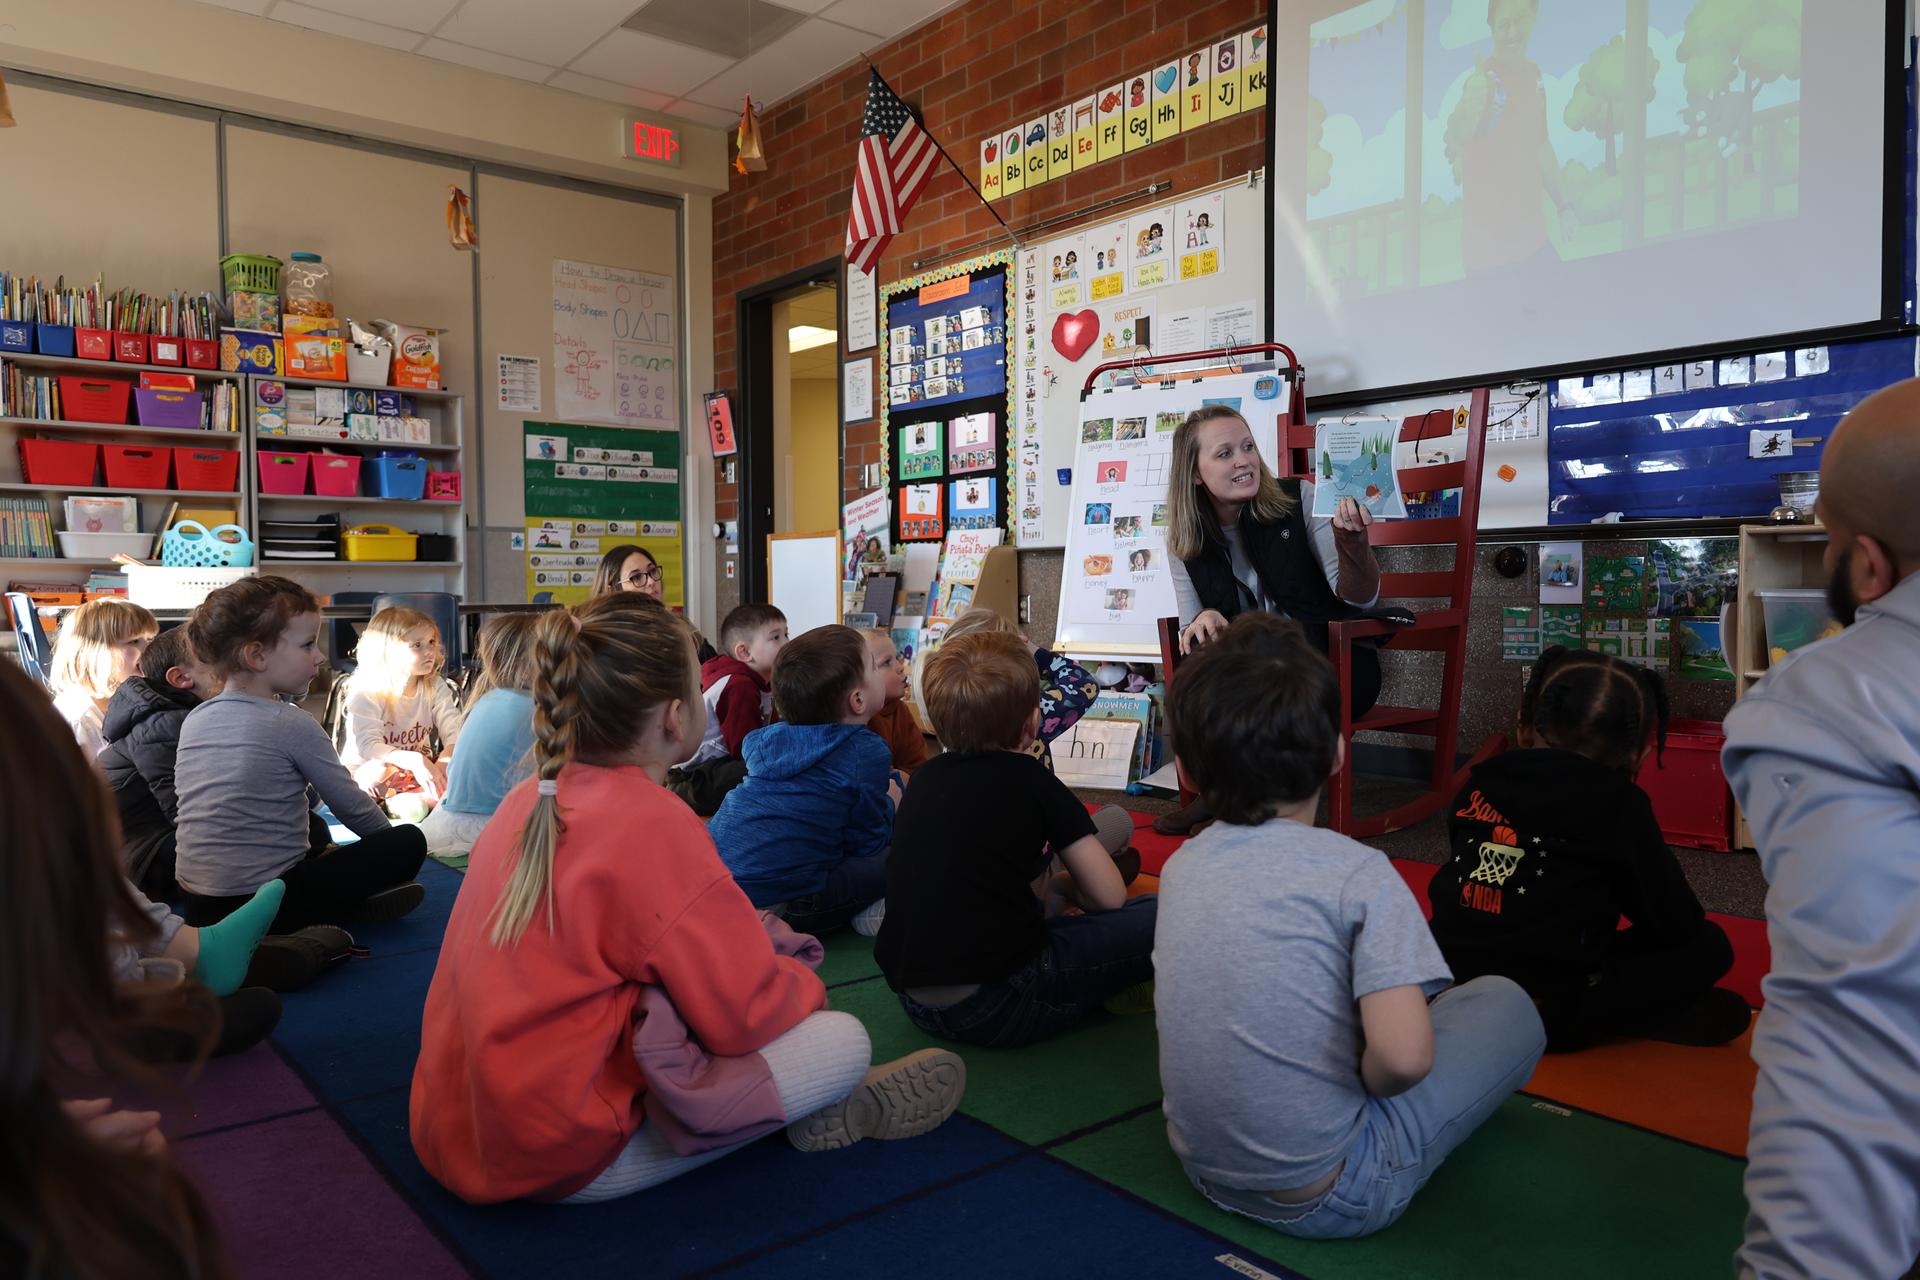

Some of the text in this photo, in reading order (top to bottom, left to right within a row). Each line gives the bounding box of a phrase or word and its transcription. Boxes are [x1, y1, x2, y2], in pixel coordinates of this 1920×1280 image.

[1249, 71, 1267, 92] Kk
[1191, 94, 1201, 113] Ii
[1218, 83, 1235, 106] Jj
[1158, 105, 1175, 124] Hh
[1104, 125, 1117, 144] Ff
[1130, 118, 1147, 137] Gg
[634, 121, 672, 160] EXIT
[1078, 137, 1093, 155] Ee
[1053, 144, 1068, 163] Dd
[1006, 164, 1020, 181] Bb
[1029, 156, 1044, 172] Cc
[984, 174, 999, 189] Aa
[553, 299, 609, 319] Body Shapes
[1114, 306, 1144, 323] RESPECT
[404, 342, 433, 354] Goldfish
[554, 332, 587, 348] Details
[1663, 366, 1675, 380] 4
[1694, 362, 1705, 377] 5
[712, 406, 726, 445] 109
[847, 495, 885, 517] Winter Season
[1092, 699, 1141, 711] SNOWMEN
[1472, 884, 1503, 915] NBA
